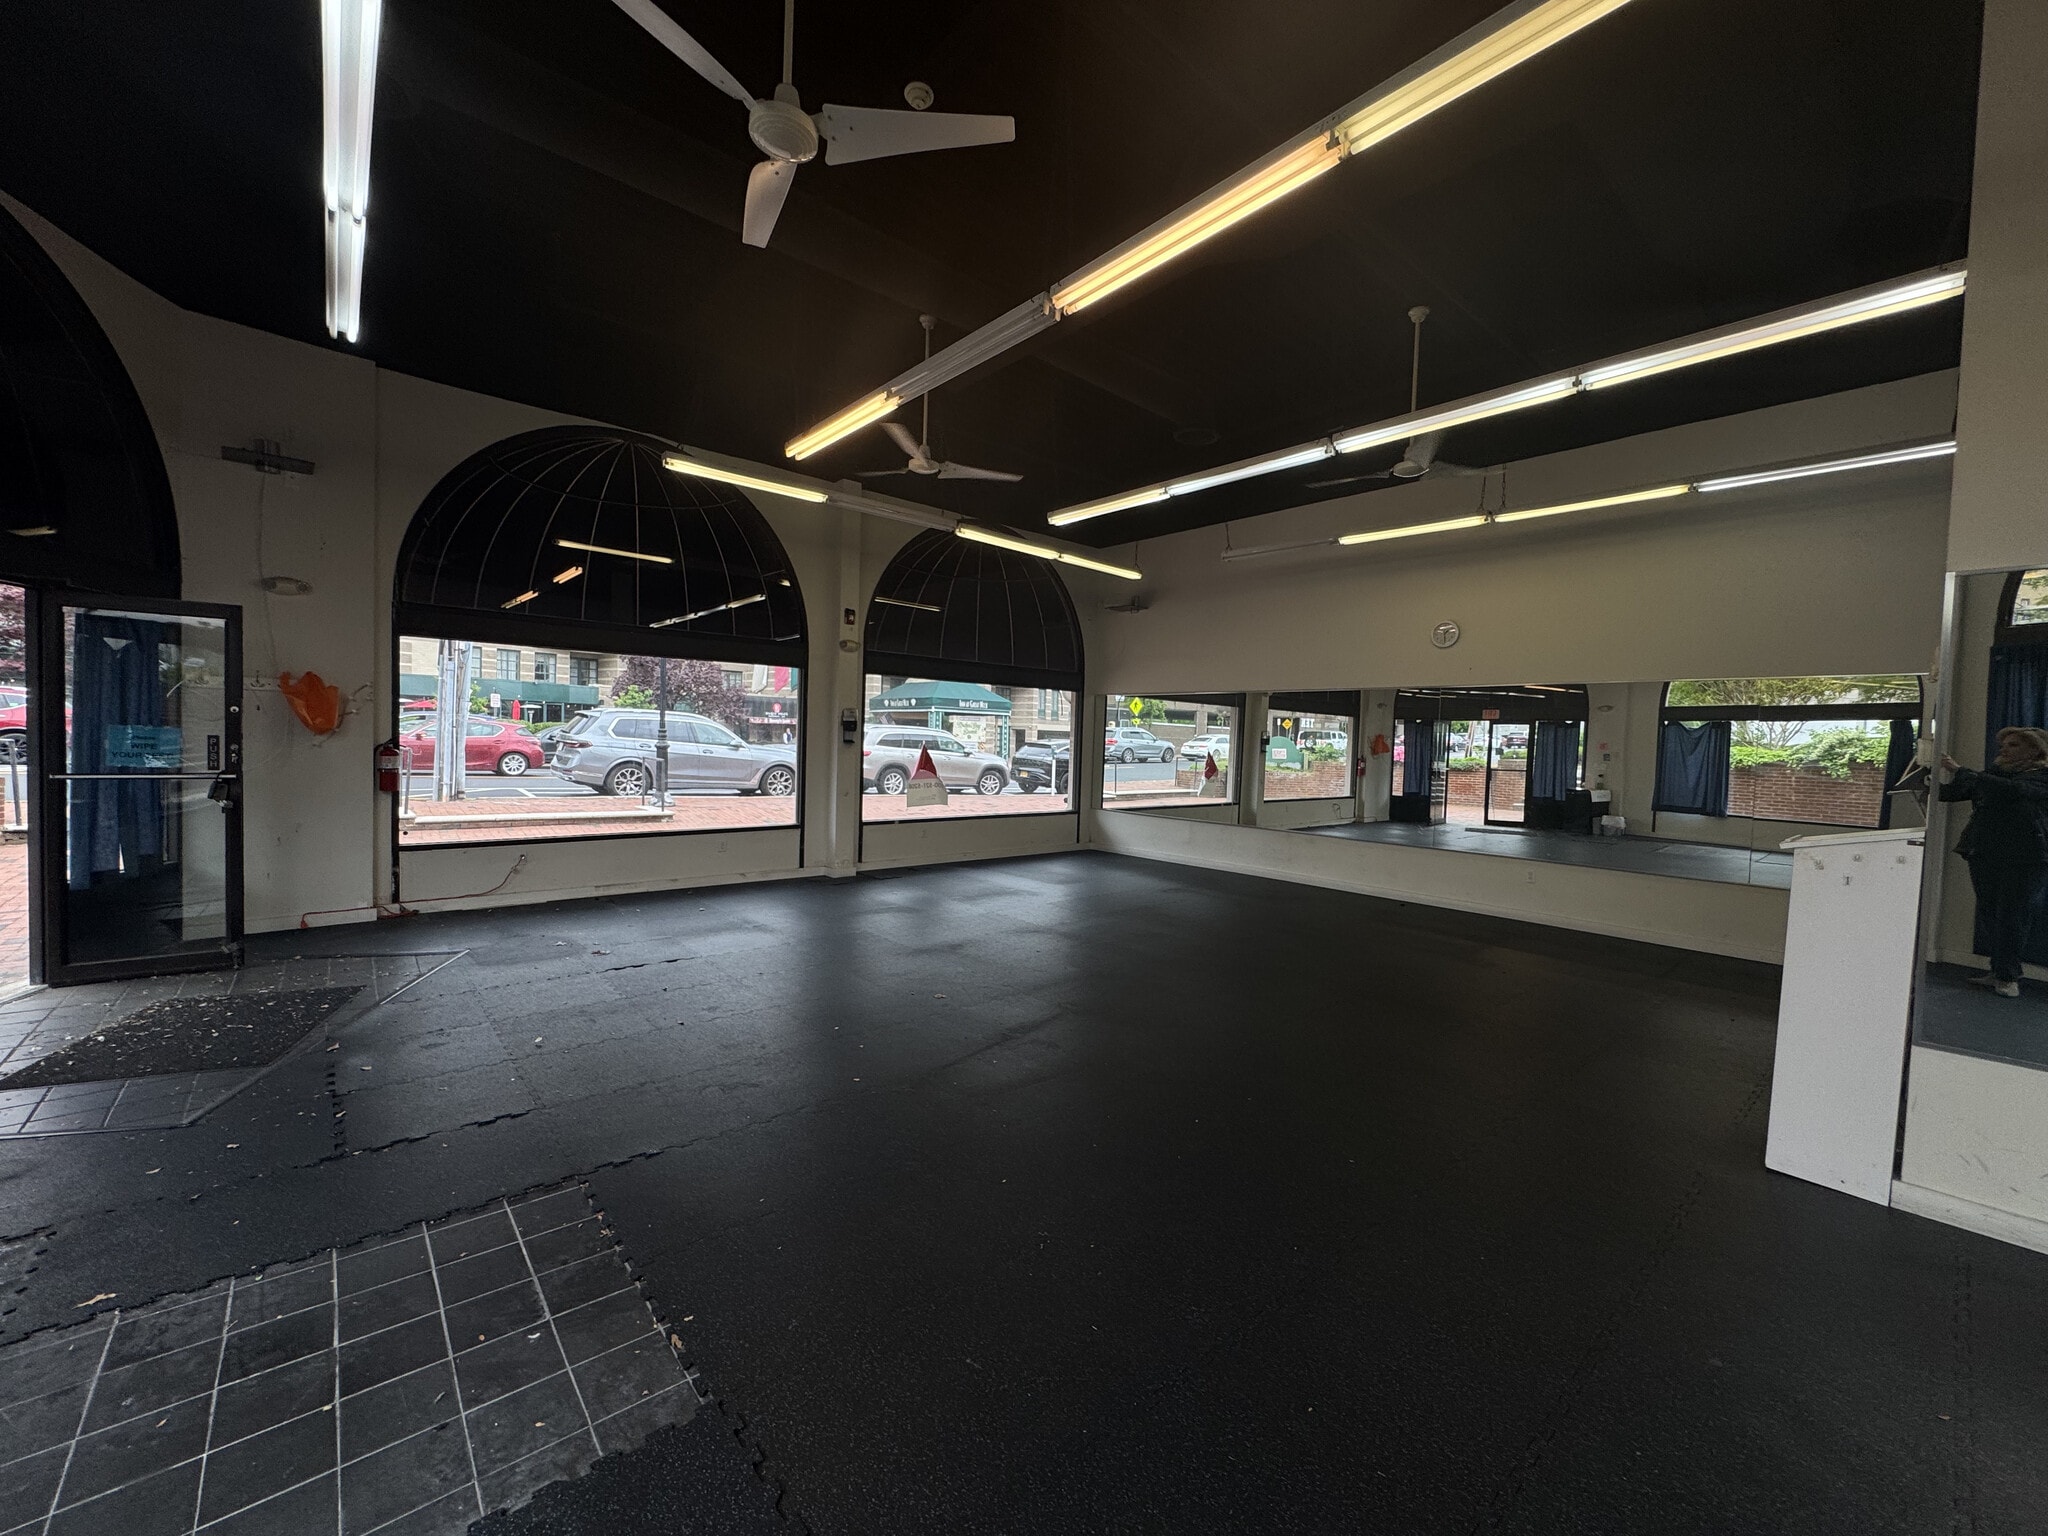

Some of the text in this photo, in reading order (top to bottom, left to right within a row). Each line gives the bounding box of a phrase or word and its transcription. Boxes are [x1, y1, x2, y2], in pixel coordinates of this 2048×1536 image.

[131, 742, 159, 750] WIPE
[111, 751, 142, 759] YOUR
[209, 737, 218, 768] PUSH
